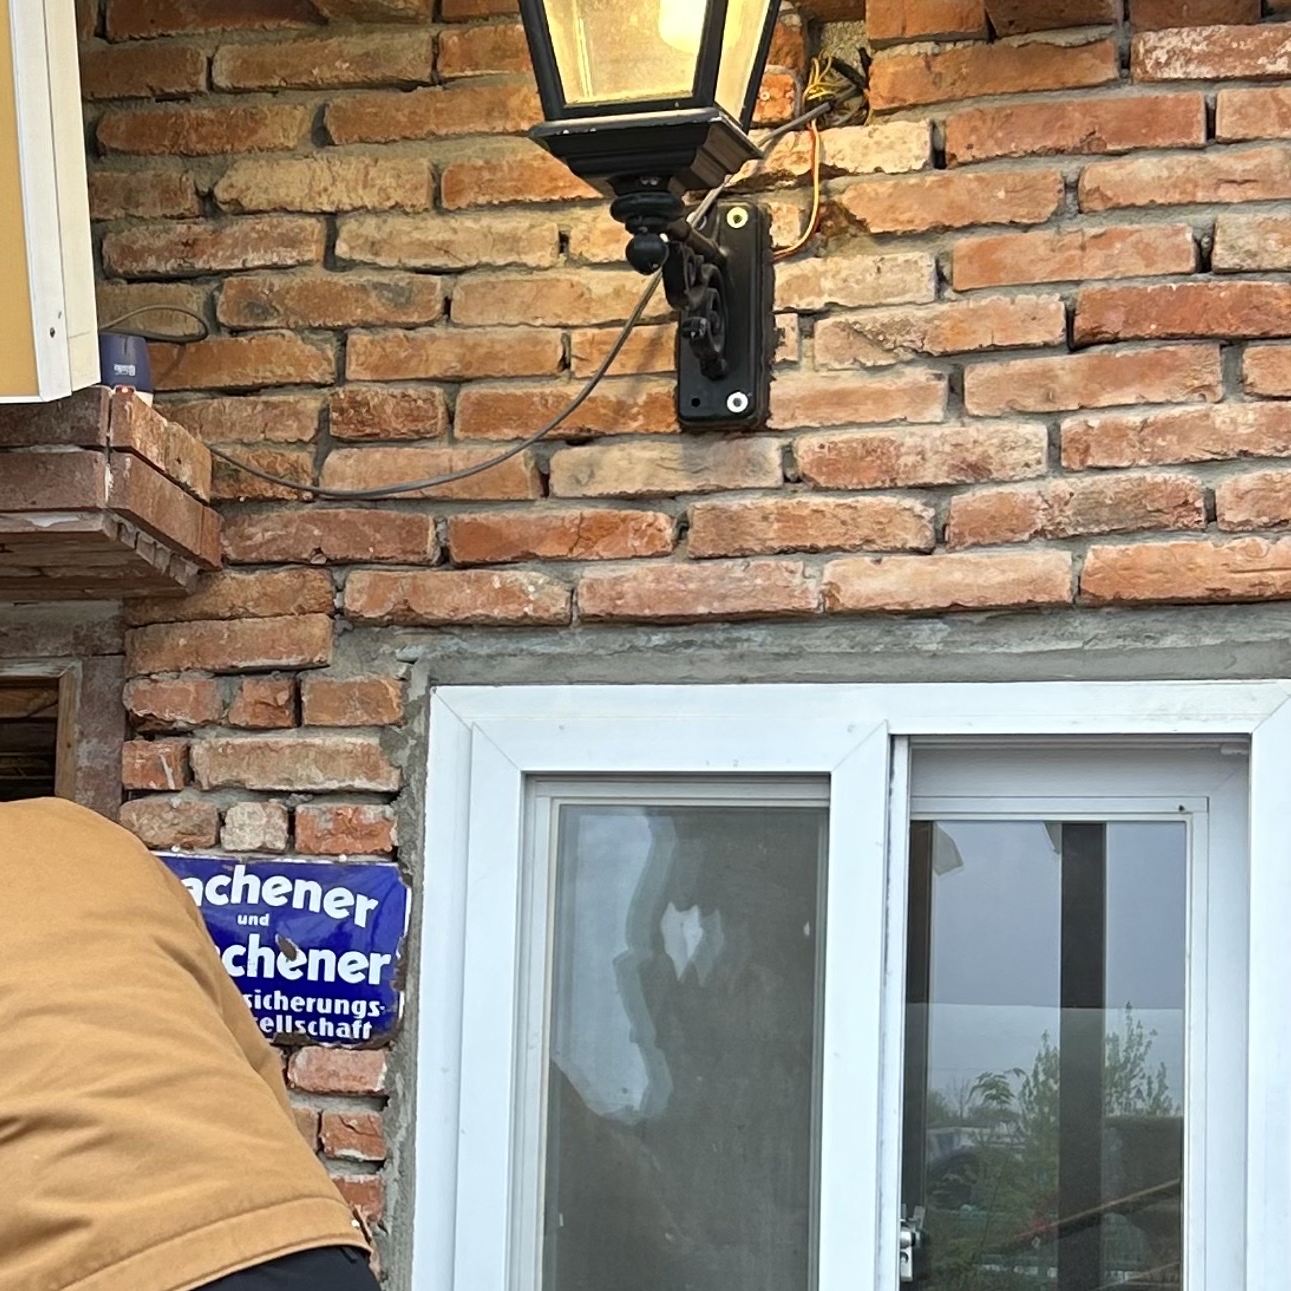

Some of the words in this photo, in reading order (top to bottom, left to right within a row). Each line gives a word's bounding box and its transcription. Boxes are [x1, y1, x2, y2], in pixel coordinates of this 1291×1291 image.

[181, 864, 379, 928] achener
[237, 913, 270, 927] und
[214, 933, 392, 985] chener
[254, 1014, 373, 1040] ellschaft
